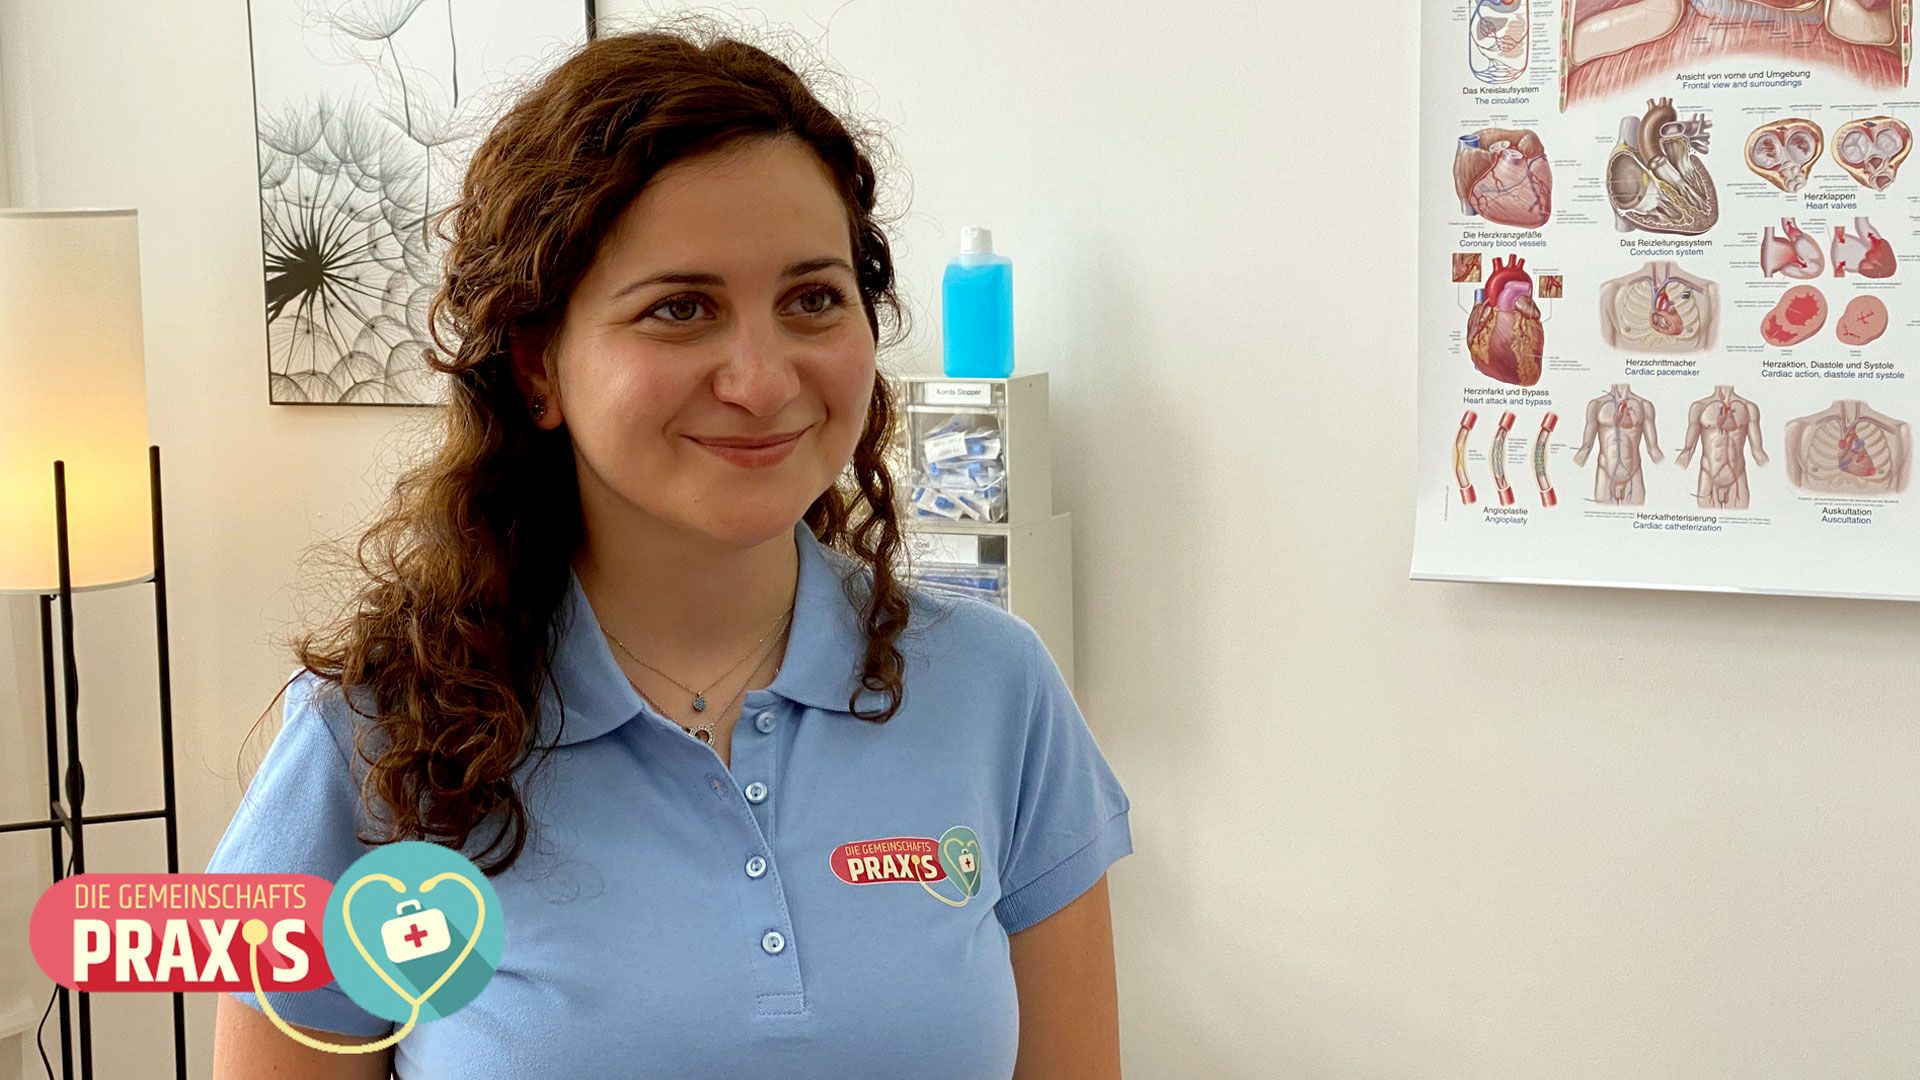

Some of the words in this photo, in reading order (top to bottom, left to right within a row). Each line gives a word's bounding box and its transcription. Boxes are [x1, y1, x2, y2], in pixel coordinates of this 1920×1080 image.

[1676, 73, 1705, 81] Ansicht
[1749, 71, 1764, 79] und
[1766, 70, 1811, 79] Umgebung
[1682, 81, 1710, 89] Frontal
[1732, 80, 1748, 88] and
[1750, 79, 1802, 88] surroundings
[1480, 86, 1539, 96] Kreislaufsystem
[1475, 97, 1489, 105] The
[1490, 96, 1529, 105] circulation
[1804, 192, 1856, 202] Herzklappen
[1459, 240, 1494, 248] Coronary
[1496, 239, 1517, 247] blood
[1519, 239, 1547, 247] vessels
[1638, 239, 1713, 249] Reizleitungssystem
[1630, 248, 1674, 256] Conduction
[1675, 248, 1704, 257] system
[1626, 359, 1697, 367] Herzschrittmacher
[1810, 361, 1844, 369] Diastole
[1845, 361, 1862, 369] und
[1863, 361, 1895, 370] Systole
[1625, 368, 1655, 376] Cardiac
[1656, 368, 1700, 376] pacemaker
[1761, 369, 1793, 378] Cardiac
[1794, 370, 1821, 379] action,
[1823, 370, 1856, 379] diastole
[1857, 370, 1874, 379] and
[1875, 371, 1905, 381] systole
[957, 388, 982, 396] Stopper
[1463, 387, 1504, 396] Herzinfarkt
[1506, 388, 1520, 396] und
[1521, 388, 1550, 398] Bypass
[1485, 397, 1508, 405] attack
[1509, 397, 1524, 405] and
[1525, 398, 1552, 407] bypass
[1483, 506, 1528, 517] Angioplastie
[1822, 507, 1872, 516] Auskultation
[1485, 515, 1528, 525] Angioplasty
[1636, 512, 1717, 524] Herzkatheterisierung
[1821, 515, 1872, 525] Auscultation
[1633, 521, 1663, 530] Cardiac
[1664, 522, 1722, 532] catheterization
[844, 845, 861, 856] DIE
[861, 841, 932, 854] GEMEINSCHAFTS
